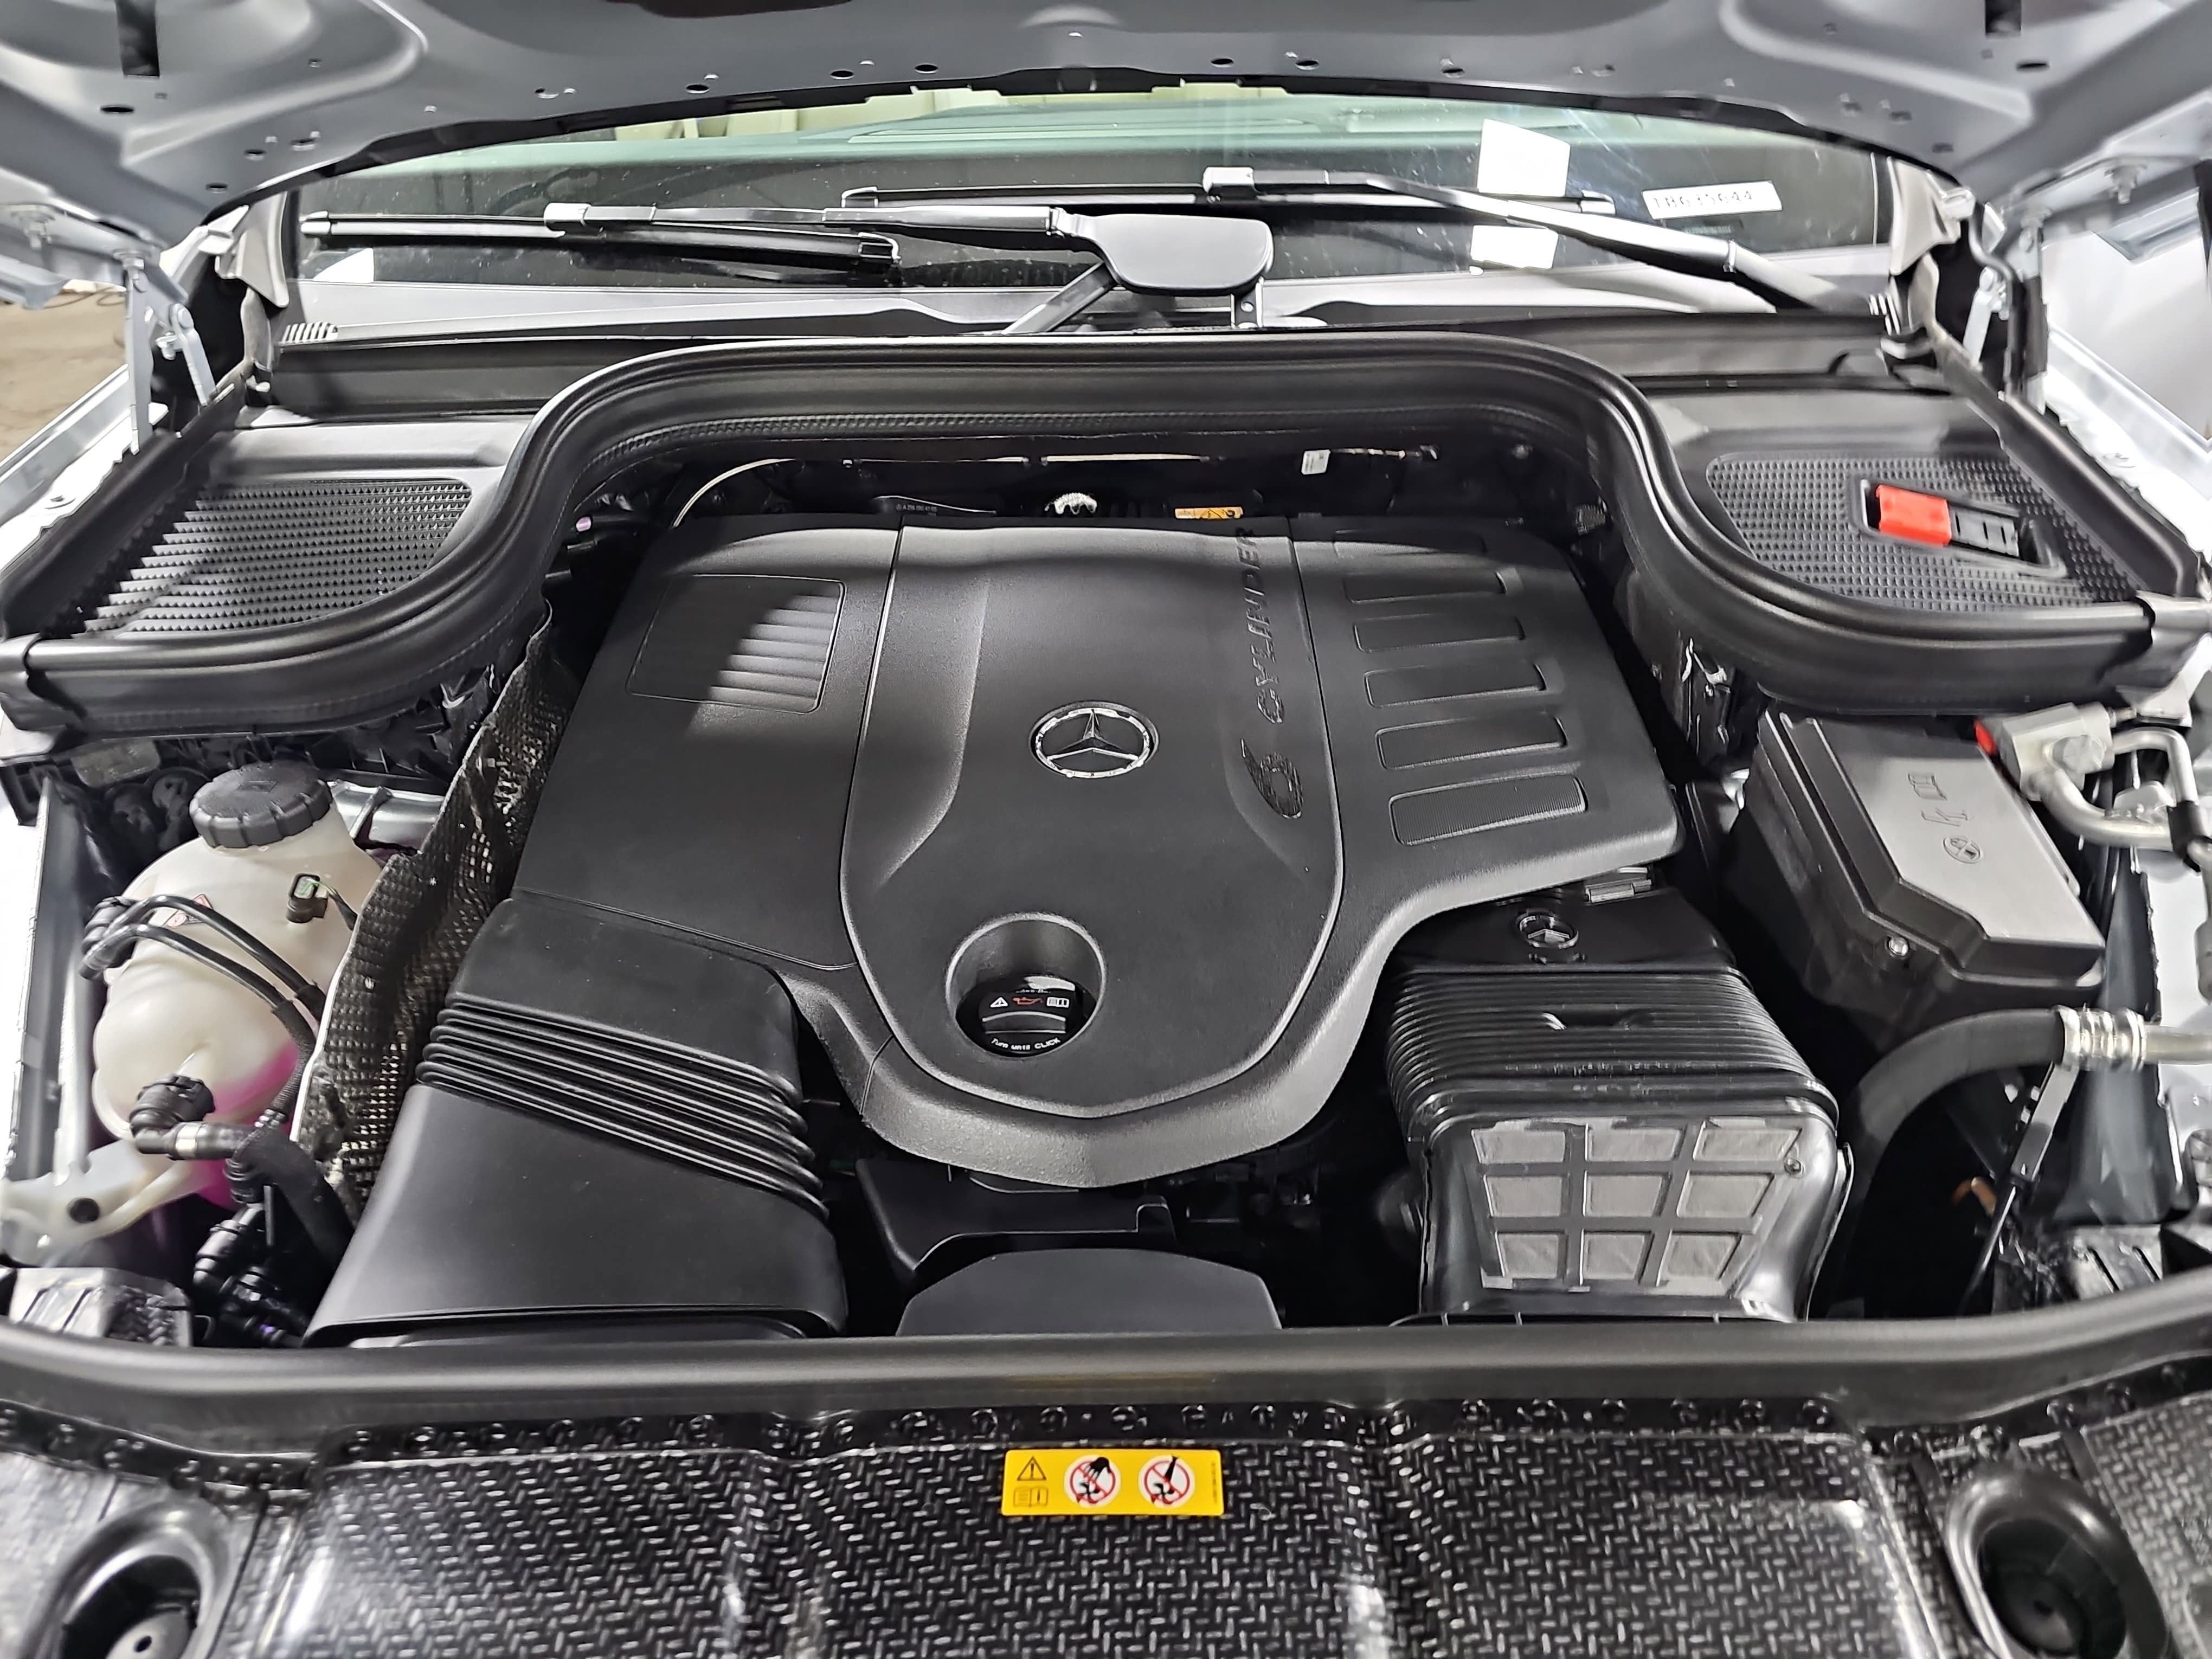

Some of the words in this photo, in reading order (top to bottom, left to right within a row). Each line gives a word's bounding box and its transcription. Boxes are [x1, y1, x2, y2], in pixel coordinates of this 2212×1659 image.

[1235, 528, 1284, 723] CYLINDER
[1240, 738, 1303, 819] 6
[991, 1038, 1008, 1049] Turn
[1034, 1038, 1060, 1049] CLICK
